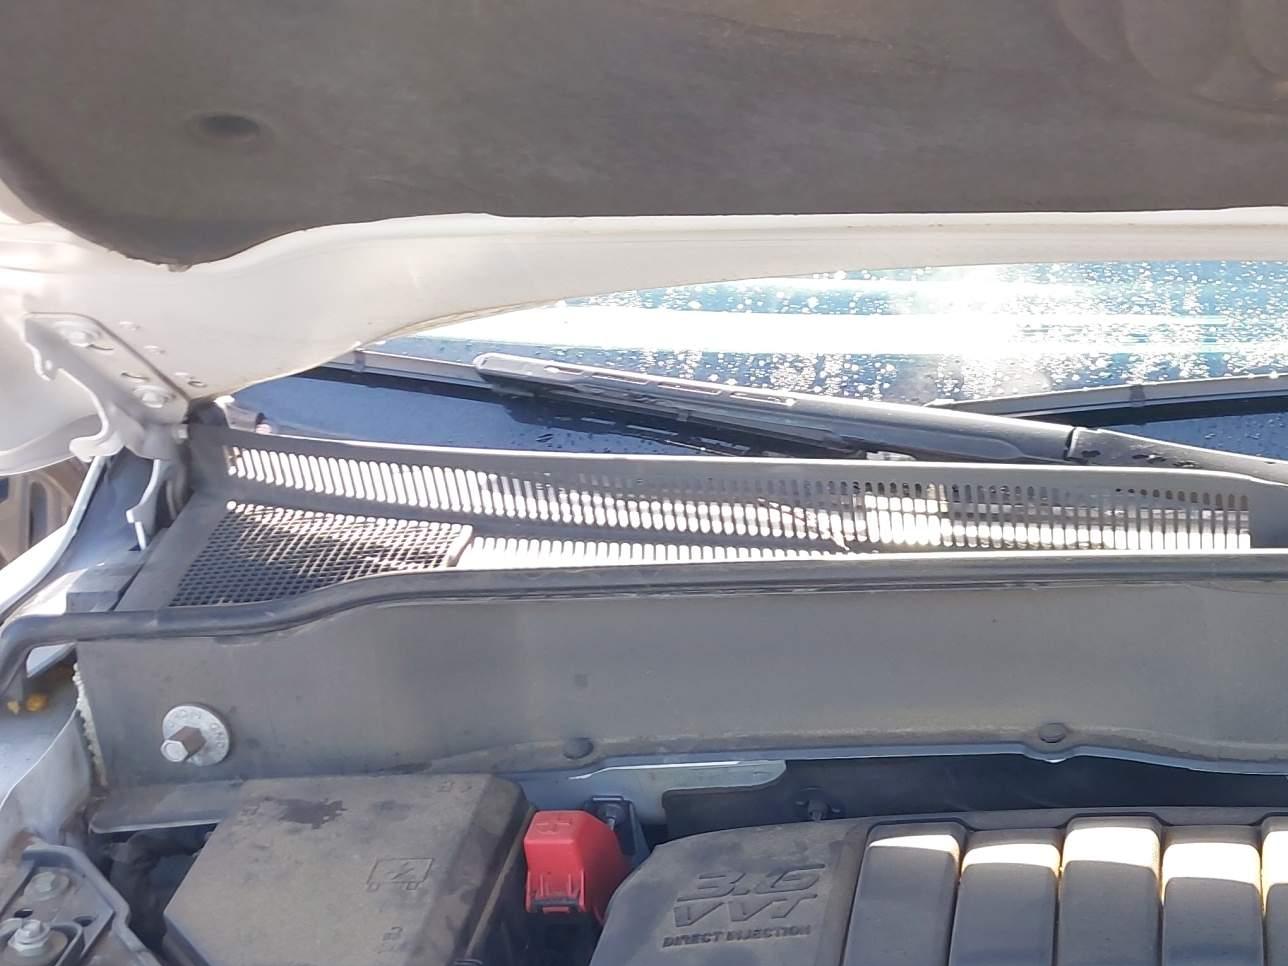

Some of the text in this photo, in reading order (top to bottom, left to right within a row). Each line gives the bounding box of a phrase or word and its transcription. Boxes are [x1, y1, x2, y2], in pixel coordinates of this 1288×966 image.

[676, 863, 826, 902] 3.6
[673, 894, 818, 928] VVT
[662, 925, 811, 948] DIRECT INJECTION
